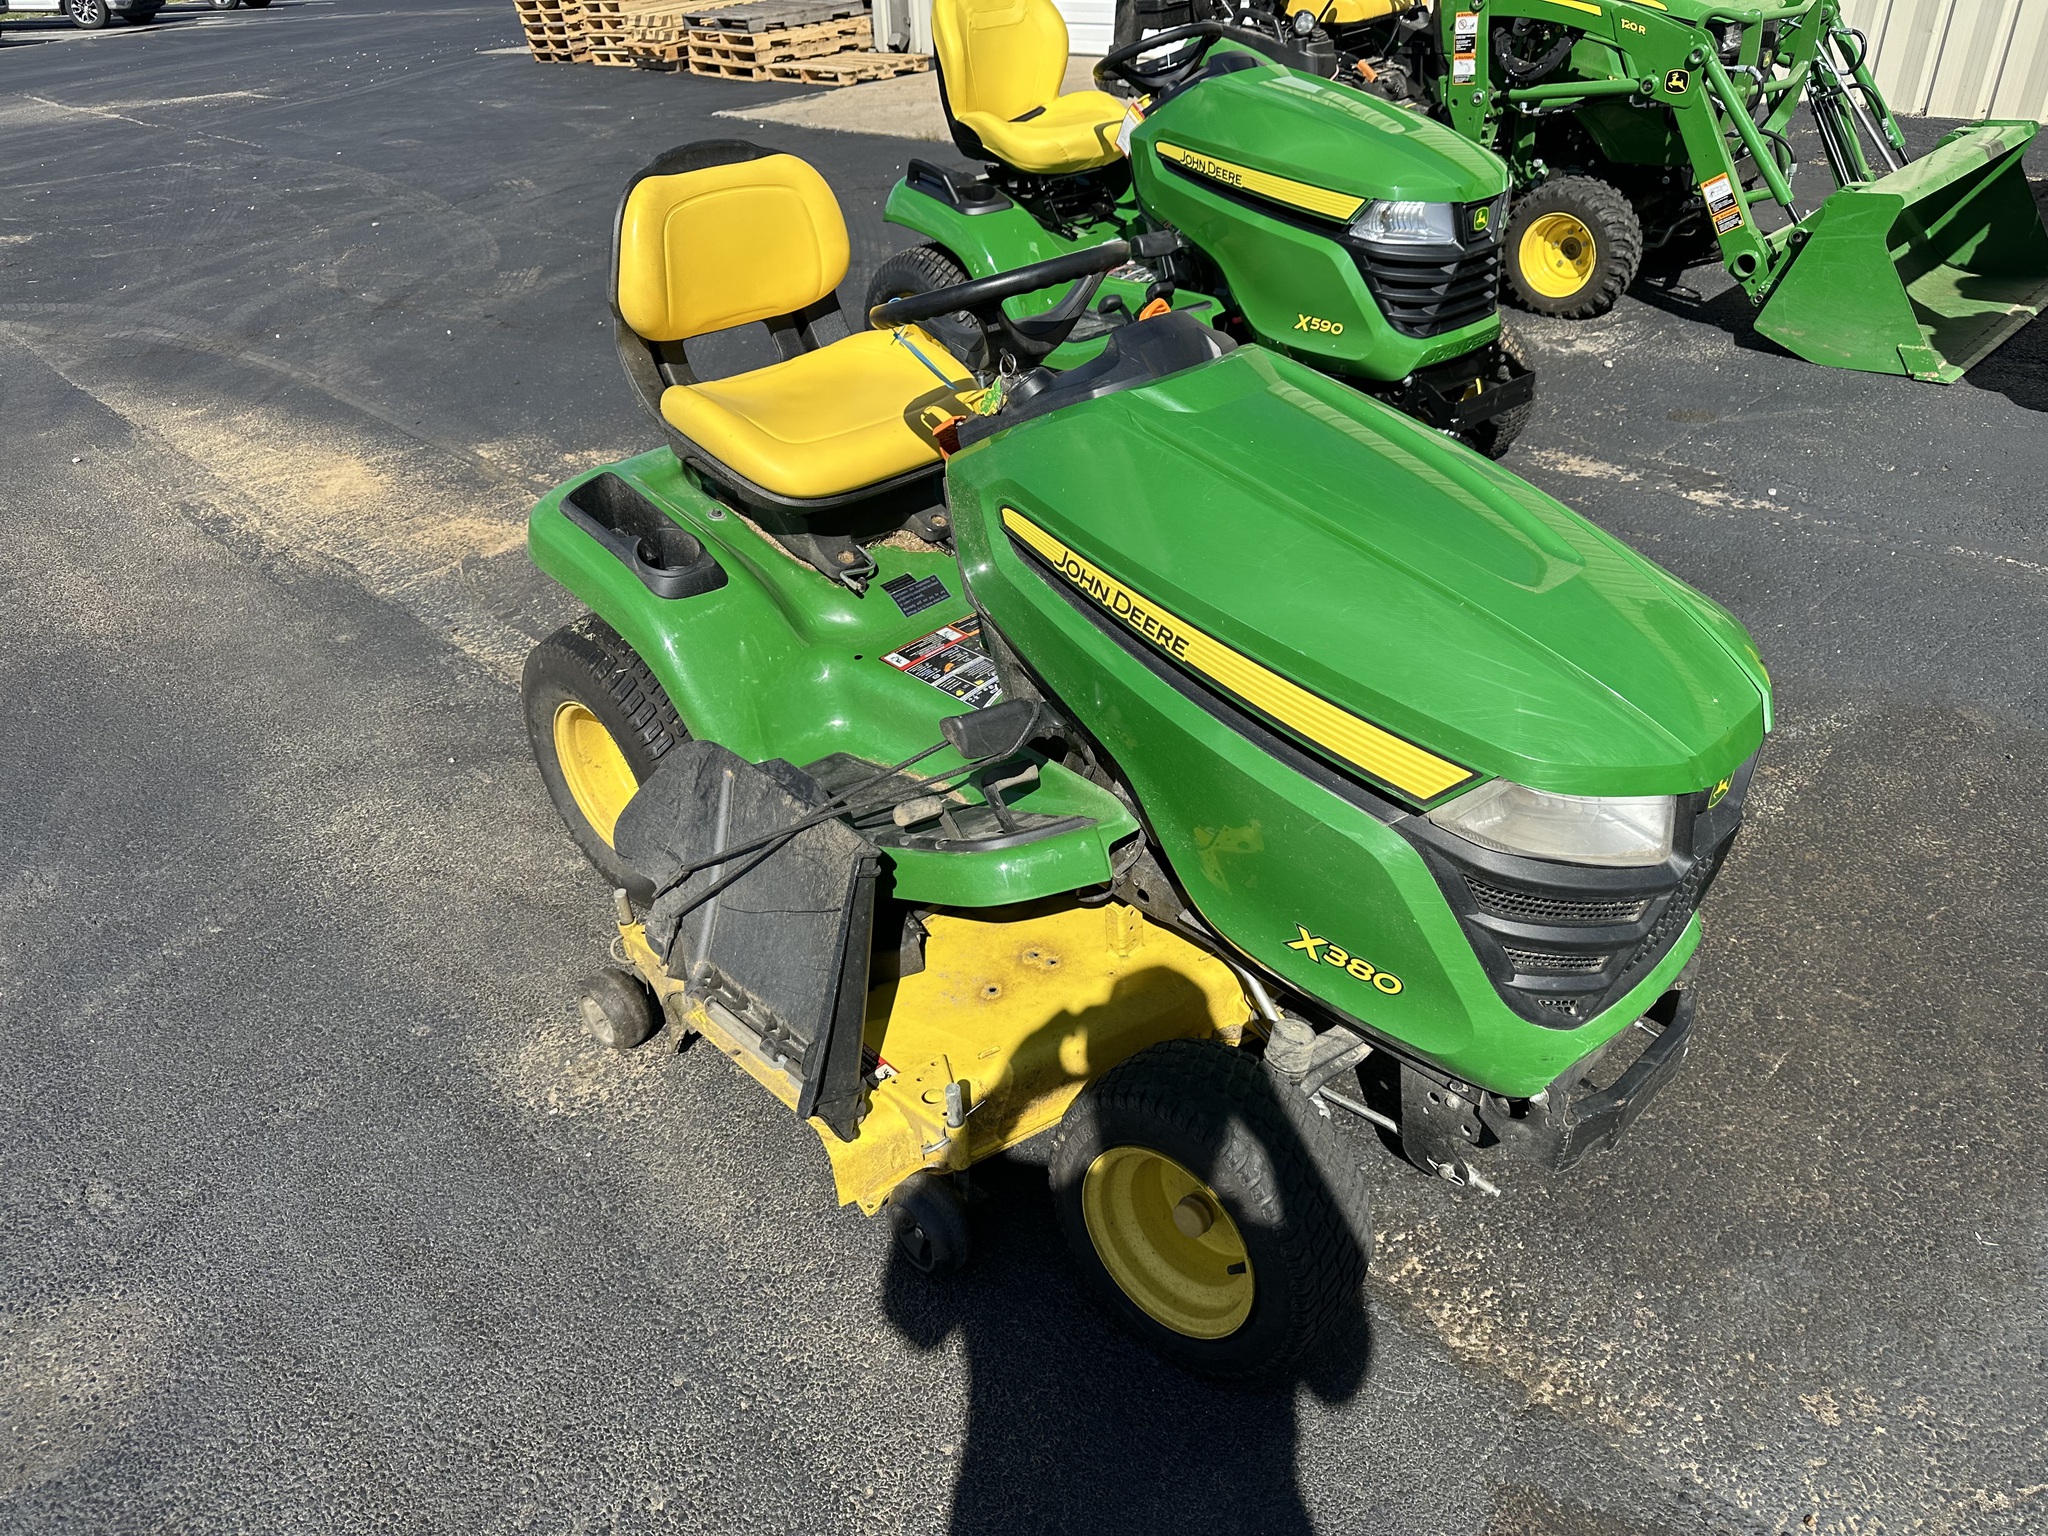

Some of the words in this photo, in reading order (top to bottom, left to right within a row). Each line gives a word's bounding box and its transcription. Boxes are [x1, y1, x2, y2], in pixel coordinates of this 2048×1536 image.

[1180, 150, 1206, 174] JOHN
[1207, 160, 1243, 187] DEERE
[1293, 313, 1344, 336] X590
[1053, 551, 1111, 604] JOHN
[1111, 589, 1190, 660] DEERE
[1283, 921, 1405, 996] X380
